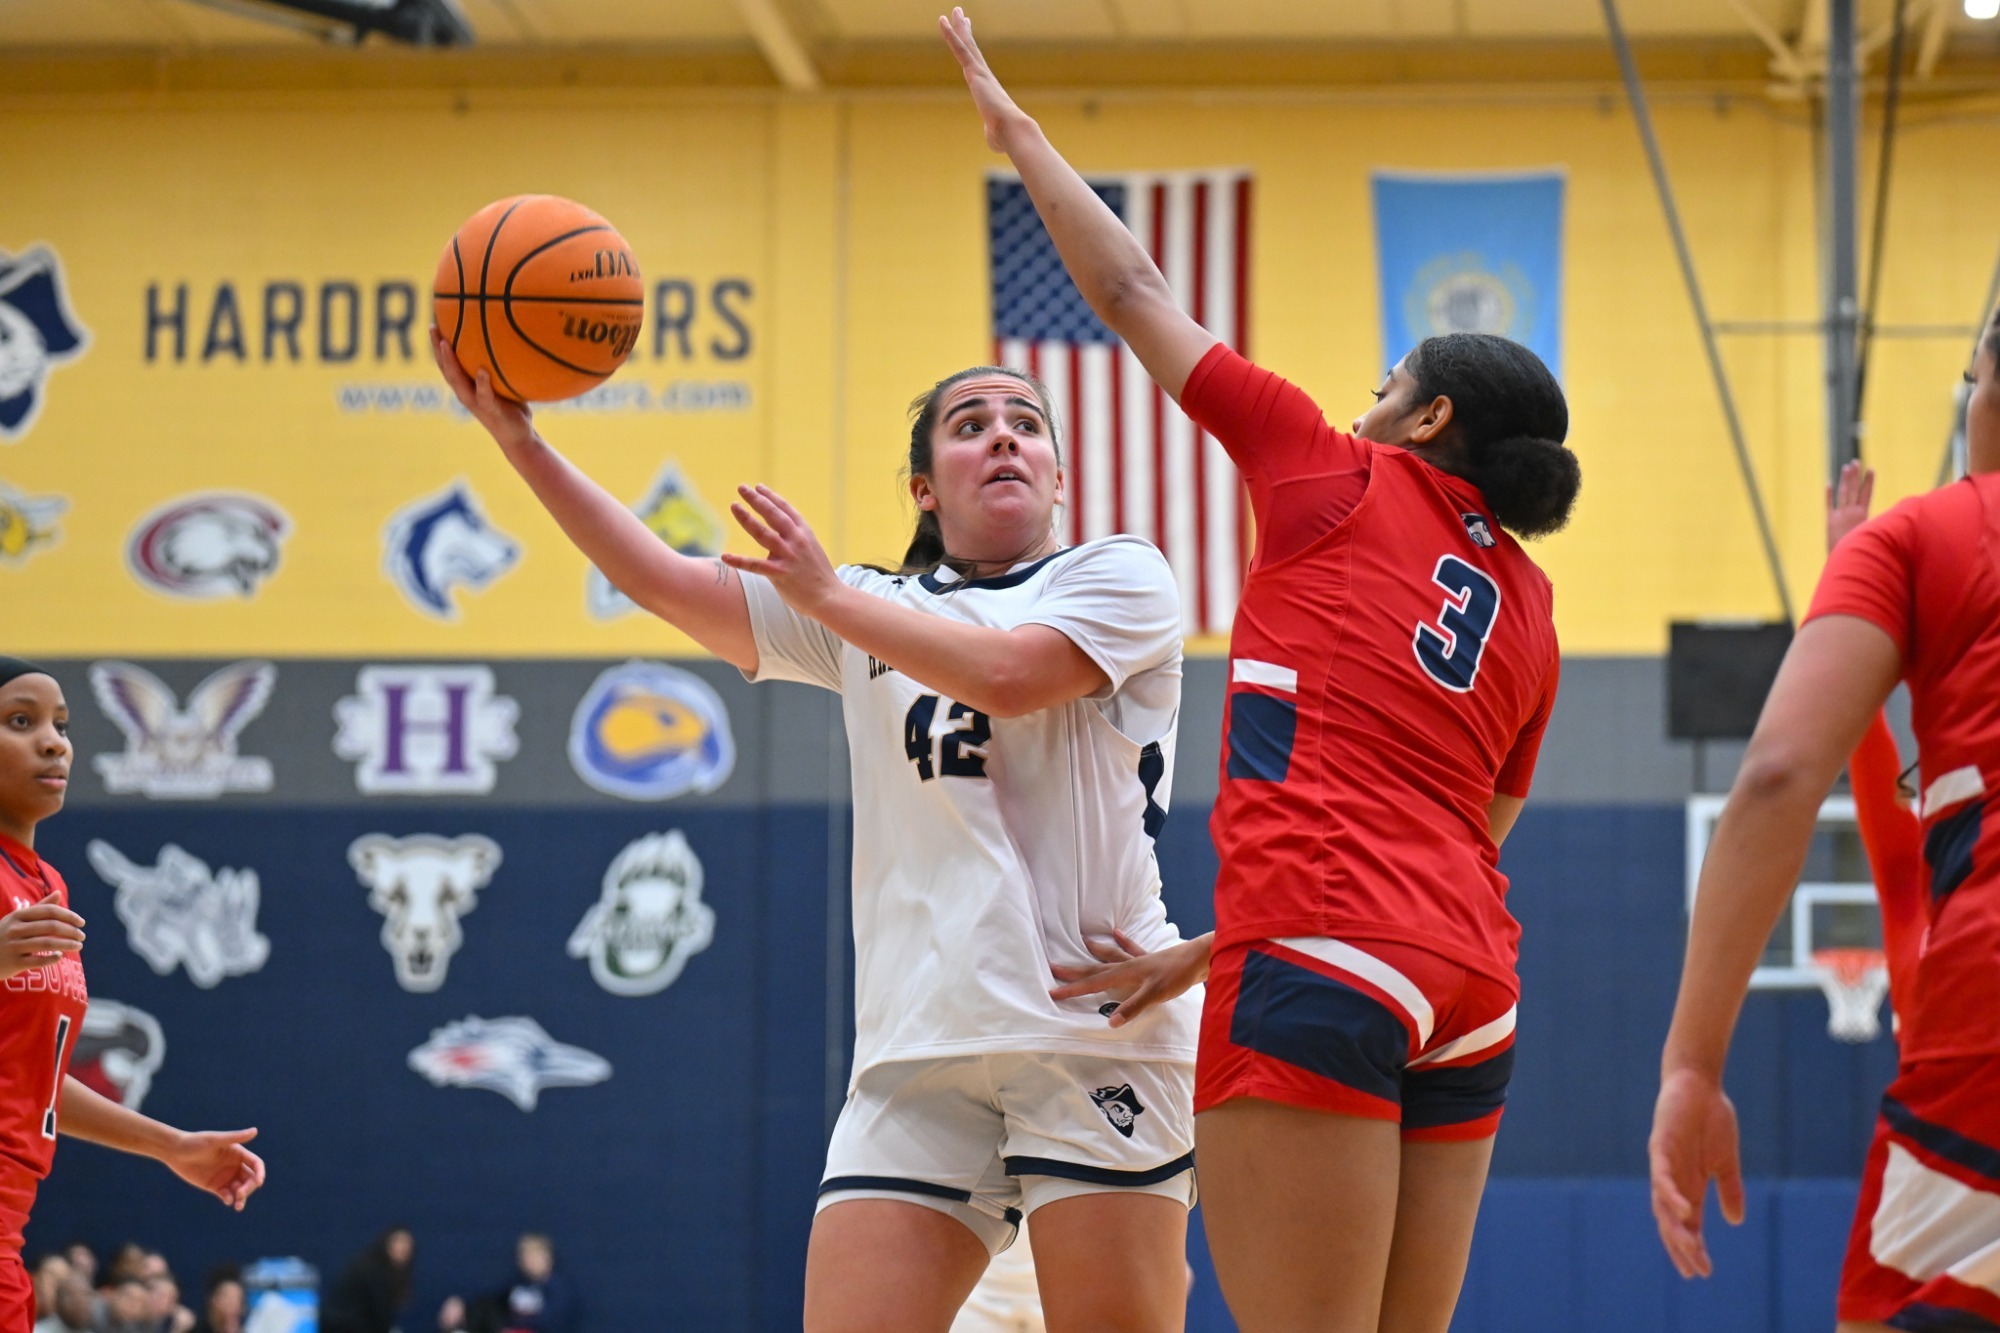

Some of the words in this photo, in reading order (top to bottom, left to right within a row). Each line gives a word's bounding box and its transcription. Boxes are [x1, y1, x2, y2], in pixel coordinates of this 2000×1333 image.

[569, 268, 594, 282] NXT
[144, 279, 752, 361] HARDRRS
[562, 314, 642, 358] ilson
[1412, 554, 1501, 692] 3
[377, 679, 476, 778] H
[905, 693, 991, 782] 42
[42, 1014, 71, 1140] 1
